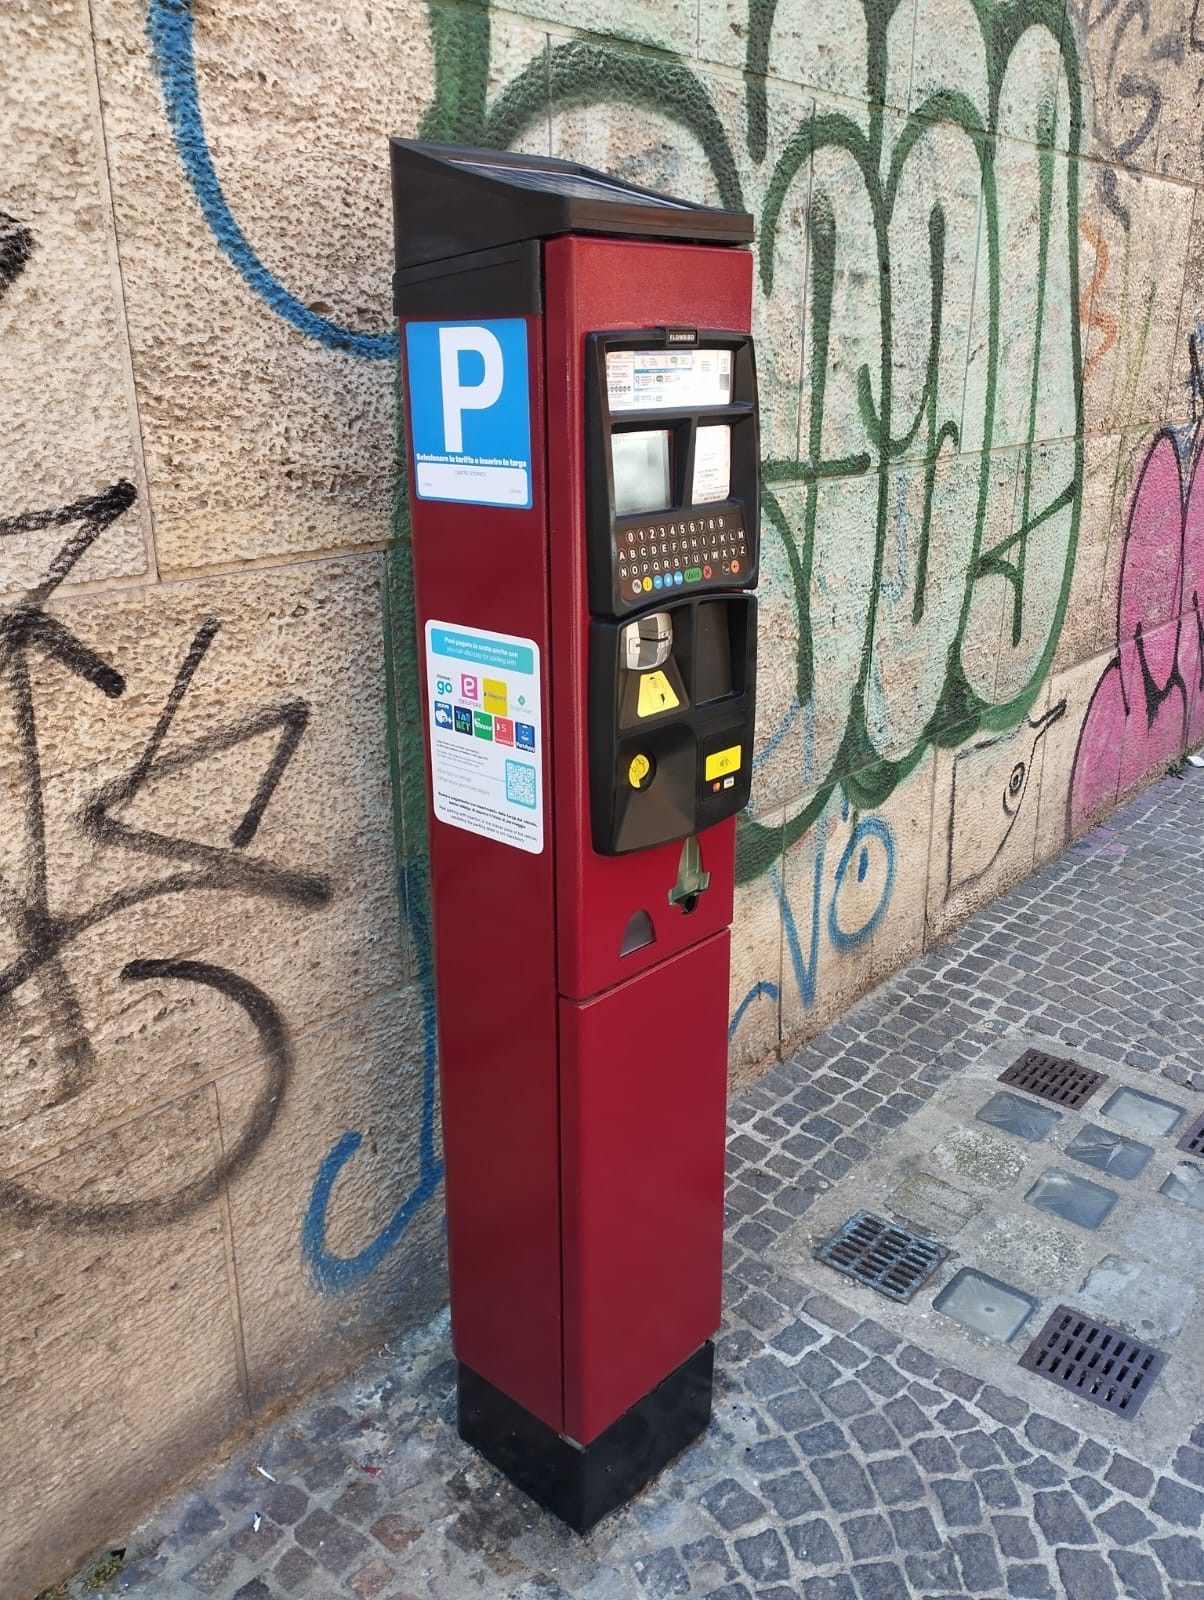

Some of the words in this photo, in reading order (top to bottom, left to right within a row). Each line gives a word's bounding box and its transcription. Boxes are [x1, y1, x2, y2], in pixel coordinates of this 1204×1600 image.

[438, 326, 504, 452] P
[650, 529, 655, 539] 2
[660, 528, 665, 537] 3
[670, 526, 675, 534] 4
[680, 524, 685, 534] 5
[690, 522, 695, 532] 6
[700, 521, 704, 530] 7
[709, 520, 714, 529] 8
[718, 518, 723, 528] 9
[619, 552, 625, 560] A
[630, 550, 636, 558] B
[641, 547, 646, 556] C
[651, 546, 657, 554] D
[662, 544, 667, 552] E
[672, 542, 676, 551] F
[682, 540, 688, 549] G
[643, 564, 648, 572] P
[653, 562, 659, 570] Q
[664, 560, 669, 568] R
[674, 558, 679, 567] S
[684, 556, 688, 564] T
[741, 546, 745, 554] Z
[437, 681, 453, 695] go
